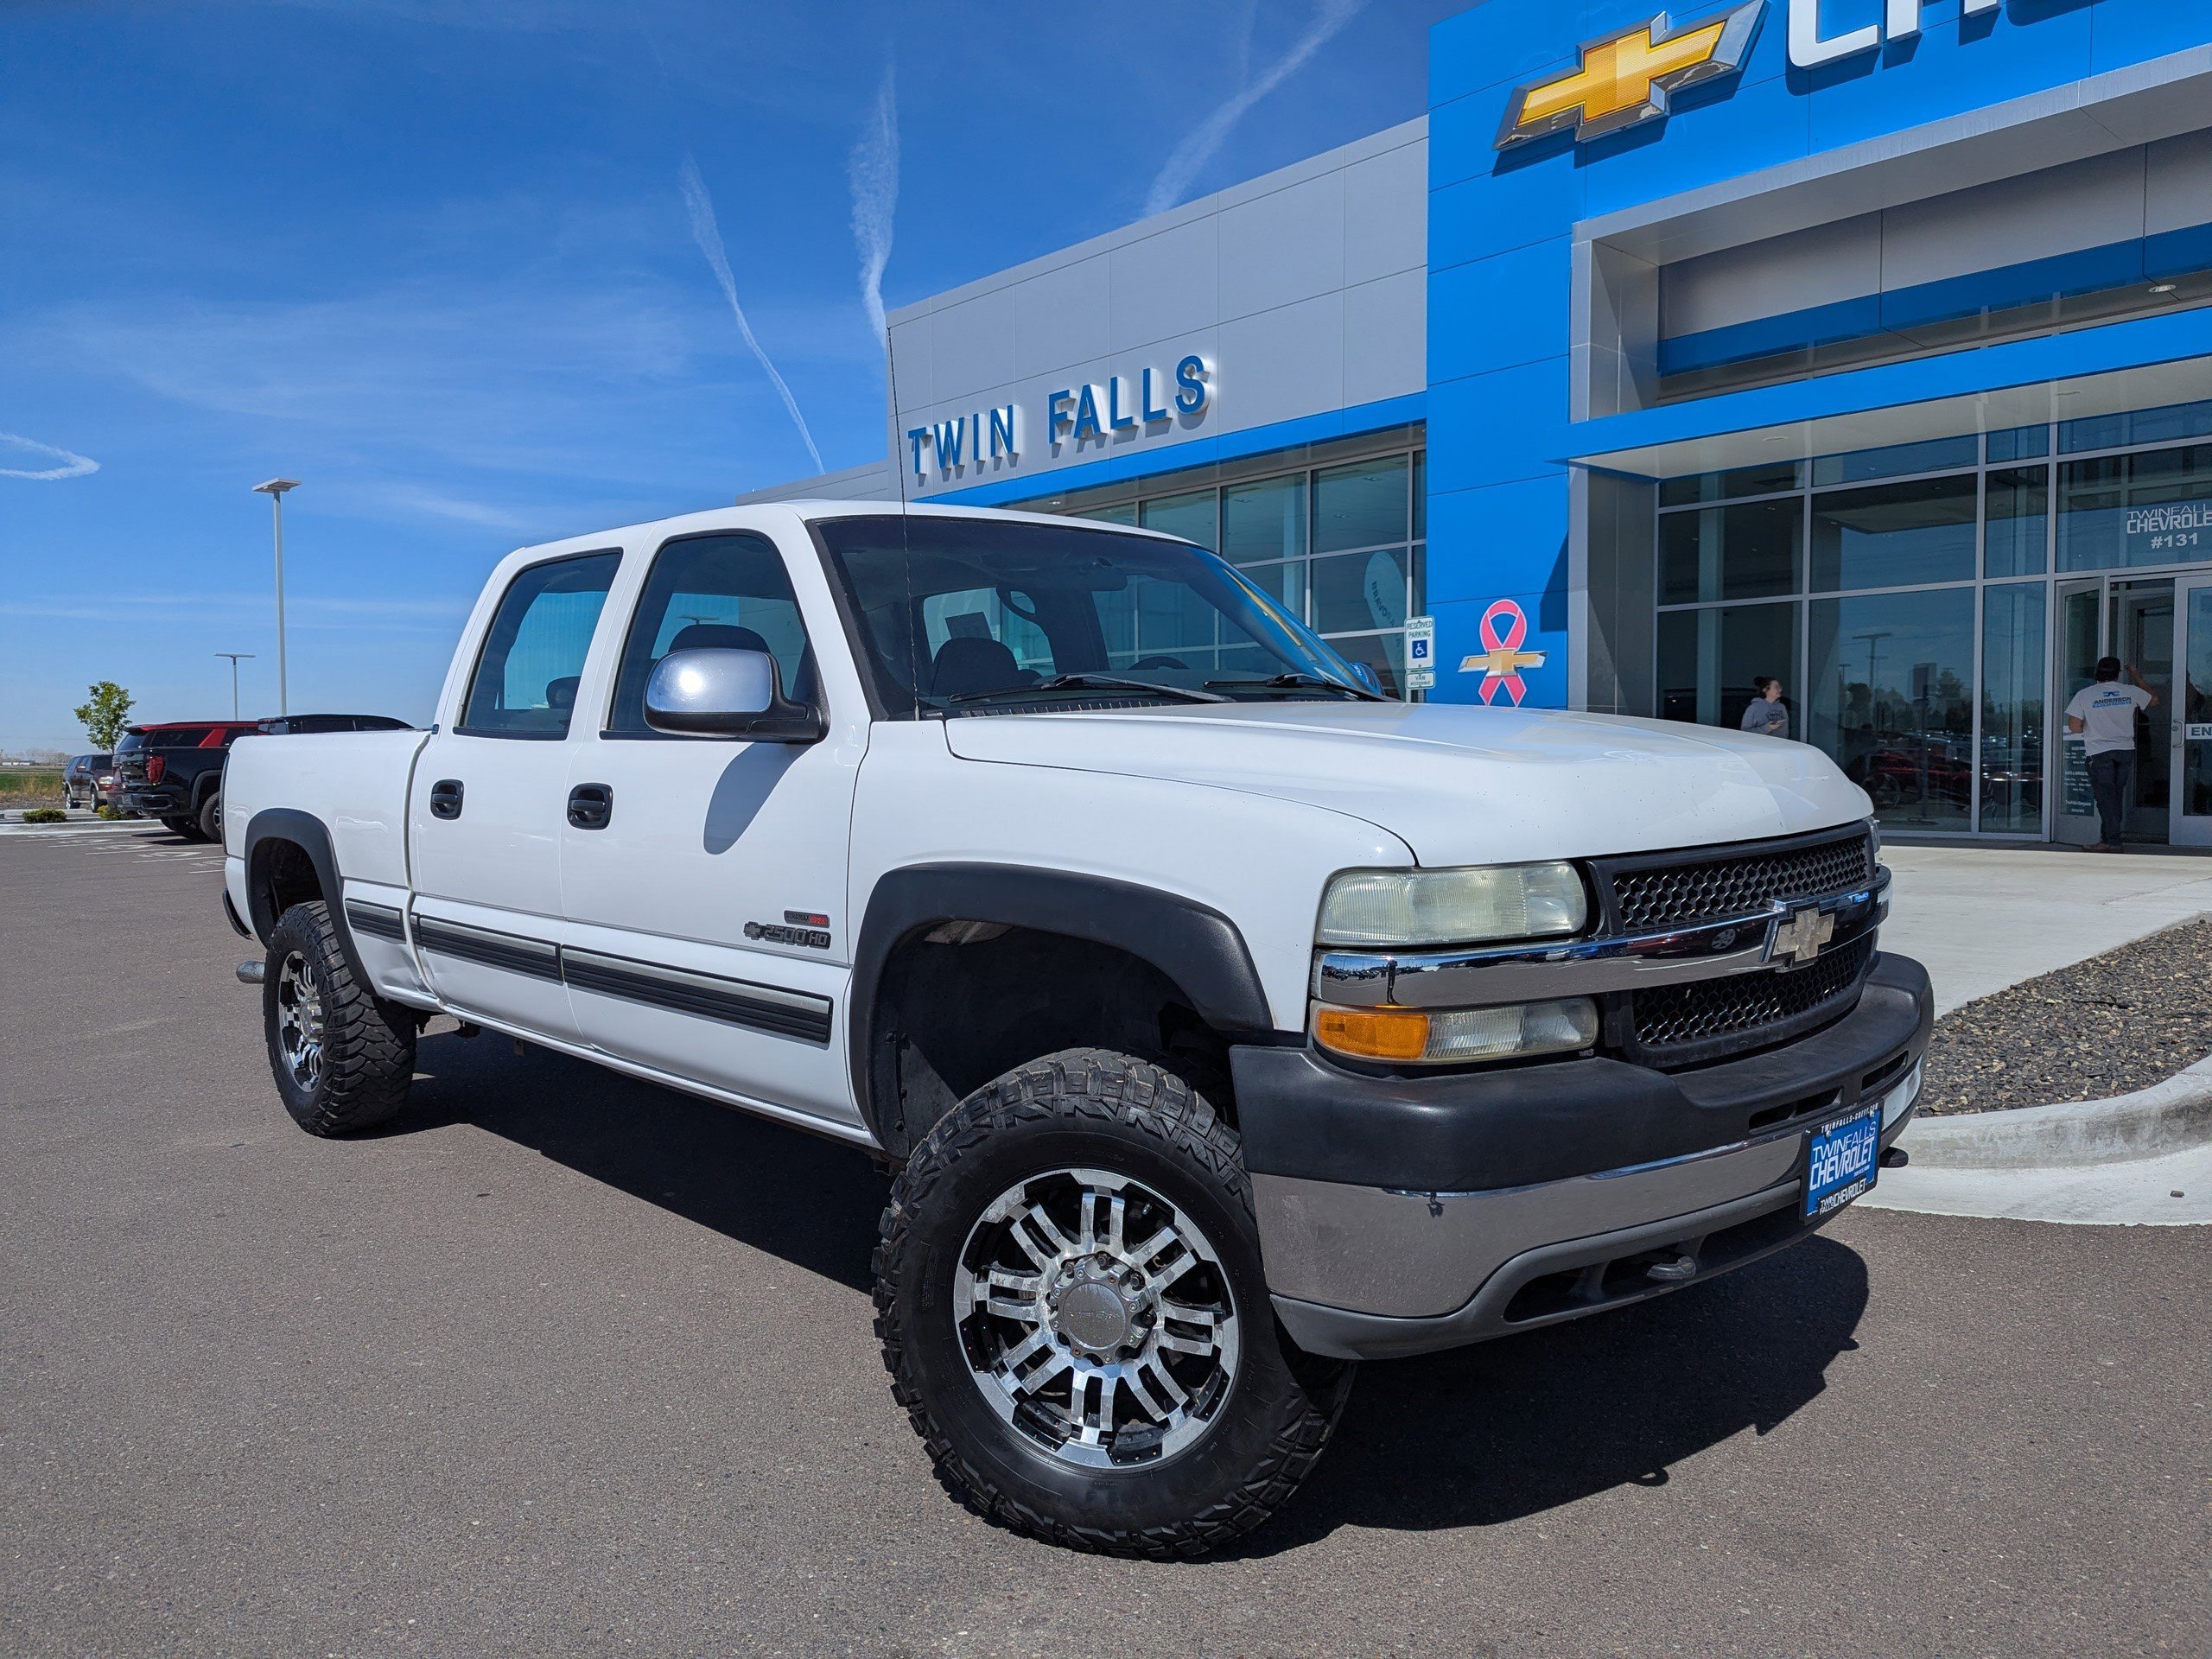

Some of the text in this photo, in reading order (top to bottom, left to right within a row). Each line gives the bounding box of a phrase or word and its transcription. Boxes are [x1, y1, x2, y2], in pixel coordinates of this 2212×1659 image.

[908, 355, 1211, 475] TWIN FALLS
[2151, 532, 2198, 549] #131
[1407, 621, 1433, 630] RESERVED
[1408, 630, 1431, 639] PARKING
[1813, 1122, 1876, 1163] TWINFALLS
[1809, 1136, 1875, 1191] CHEVROLET
[1834, 1178, 1867, 1208] CHEVROLET
